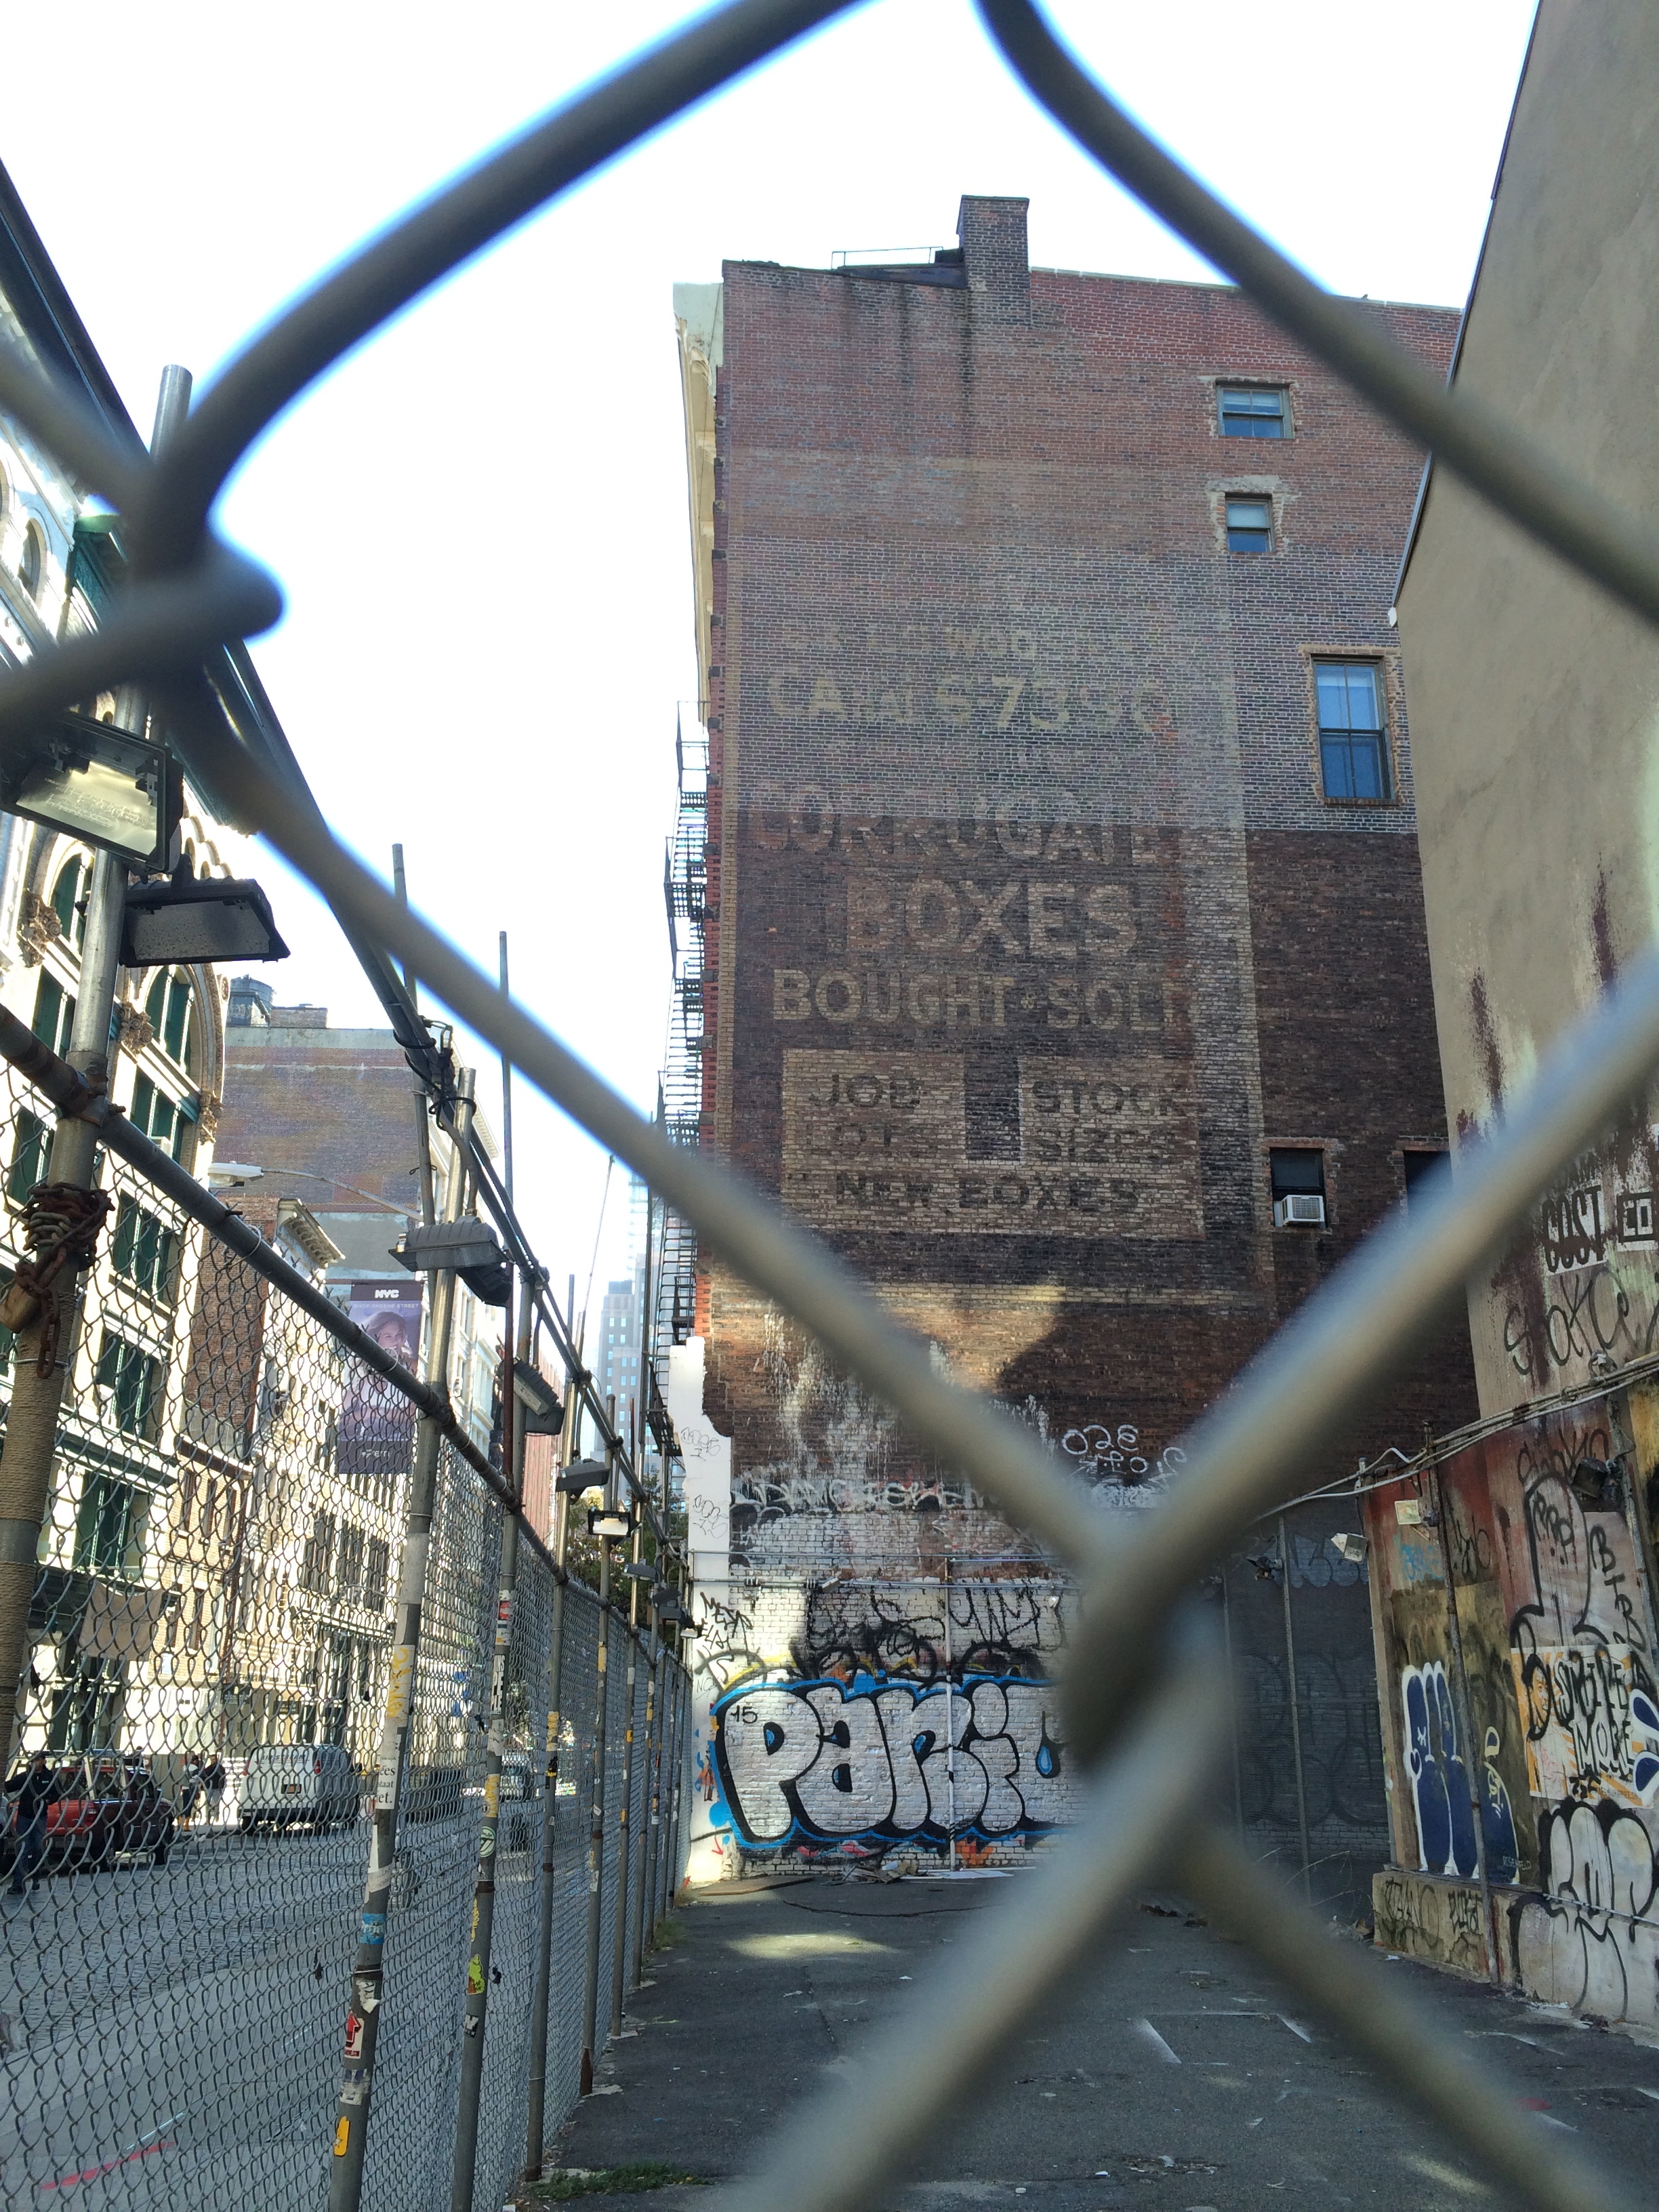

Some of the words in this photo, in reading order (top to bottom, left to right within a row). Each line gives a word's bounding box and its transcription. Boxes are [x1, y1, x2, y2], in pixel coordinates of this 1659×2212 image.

[845, 878, 1137, 960] BOXES
[772, 968, 1016, 1030] BOUGHT
[808, 1072, 920, 1109] JOB
[1033, 1080, 1186, 1116] STOCK
[1030, 1125, 1178, 1163] SIZES
[959, 1173, 1138, 1214] BOXES
[1542, 1185, 1605, 1273] COST
[375, 1290, 399, 1298] NYC
[731, 1704, 758, 1724] 15
[1572, 1721, 1635, 1778] MORE
